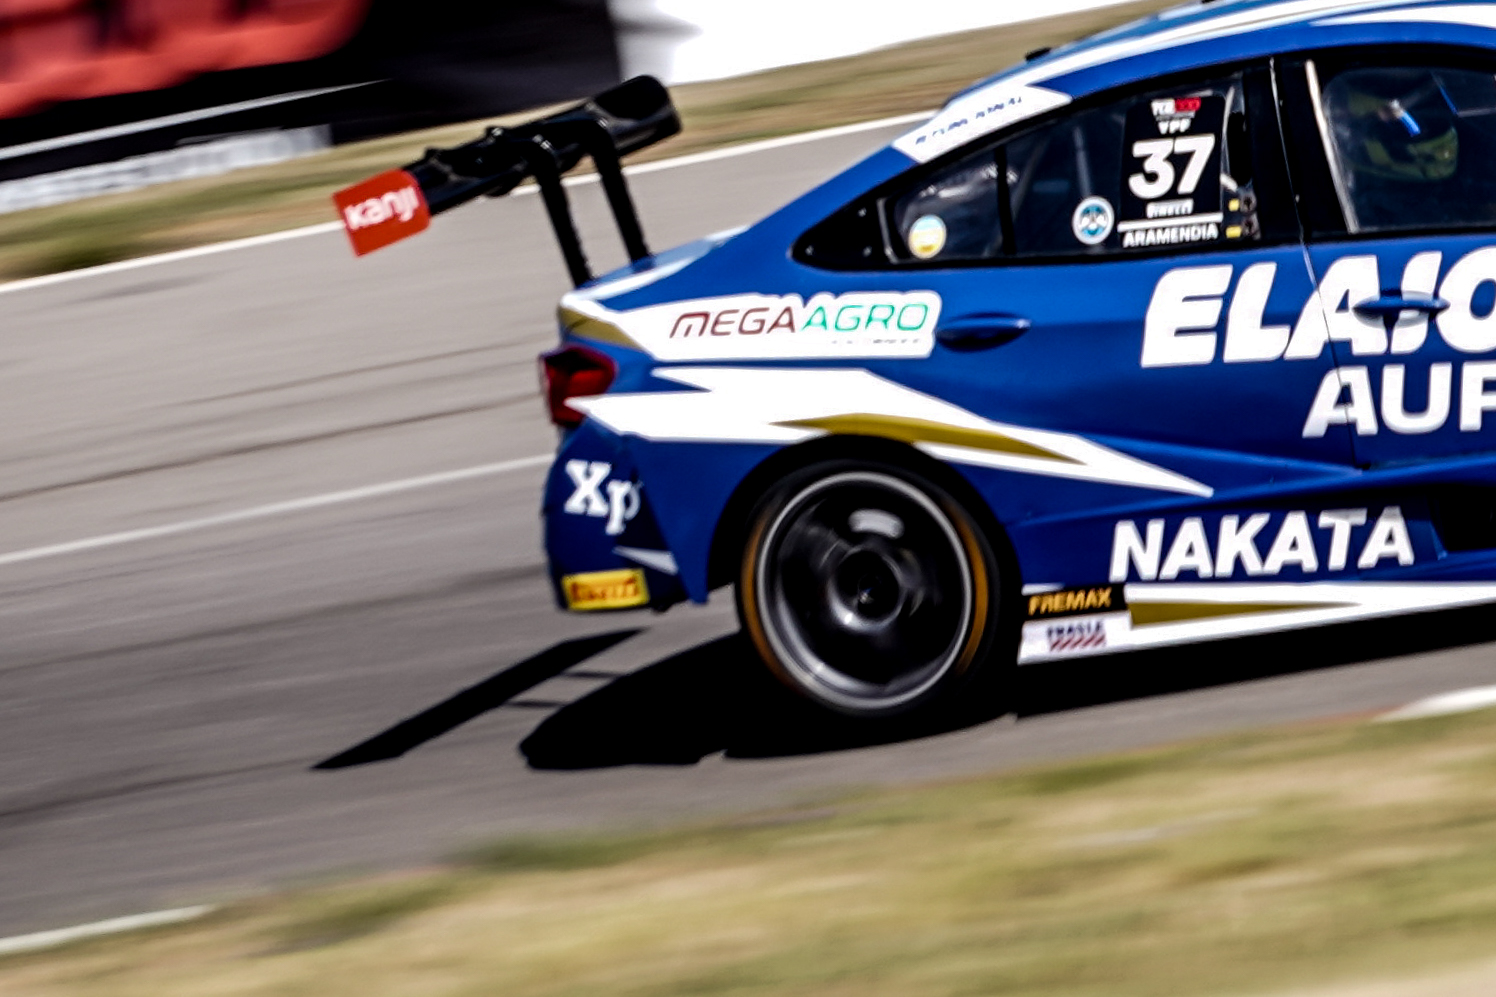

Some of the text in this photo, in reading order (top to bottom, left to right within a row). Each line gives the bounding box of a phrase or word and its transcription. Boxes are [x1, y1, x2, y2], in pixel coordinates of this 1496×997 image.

[1128, 133, 1215, 199] 37
[344, 185, 420, 230] kanji
[1123, 223, 1219, 248] ARAMENDIA
[1108, 506, 1416, 583] NAKATA
[1028, 586, 1112, 616] FREMAX
